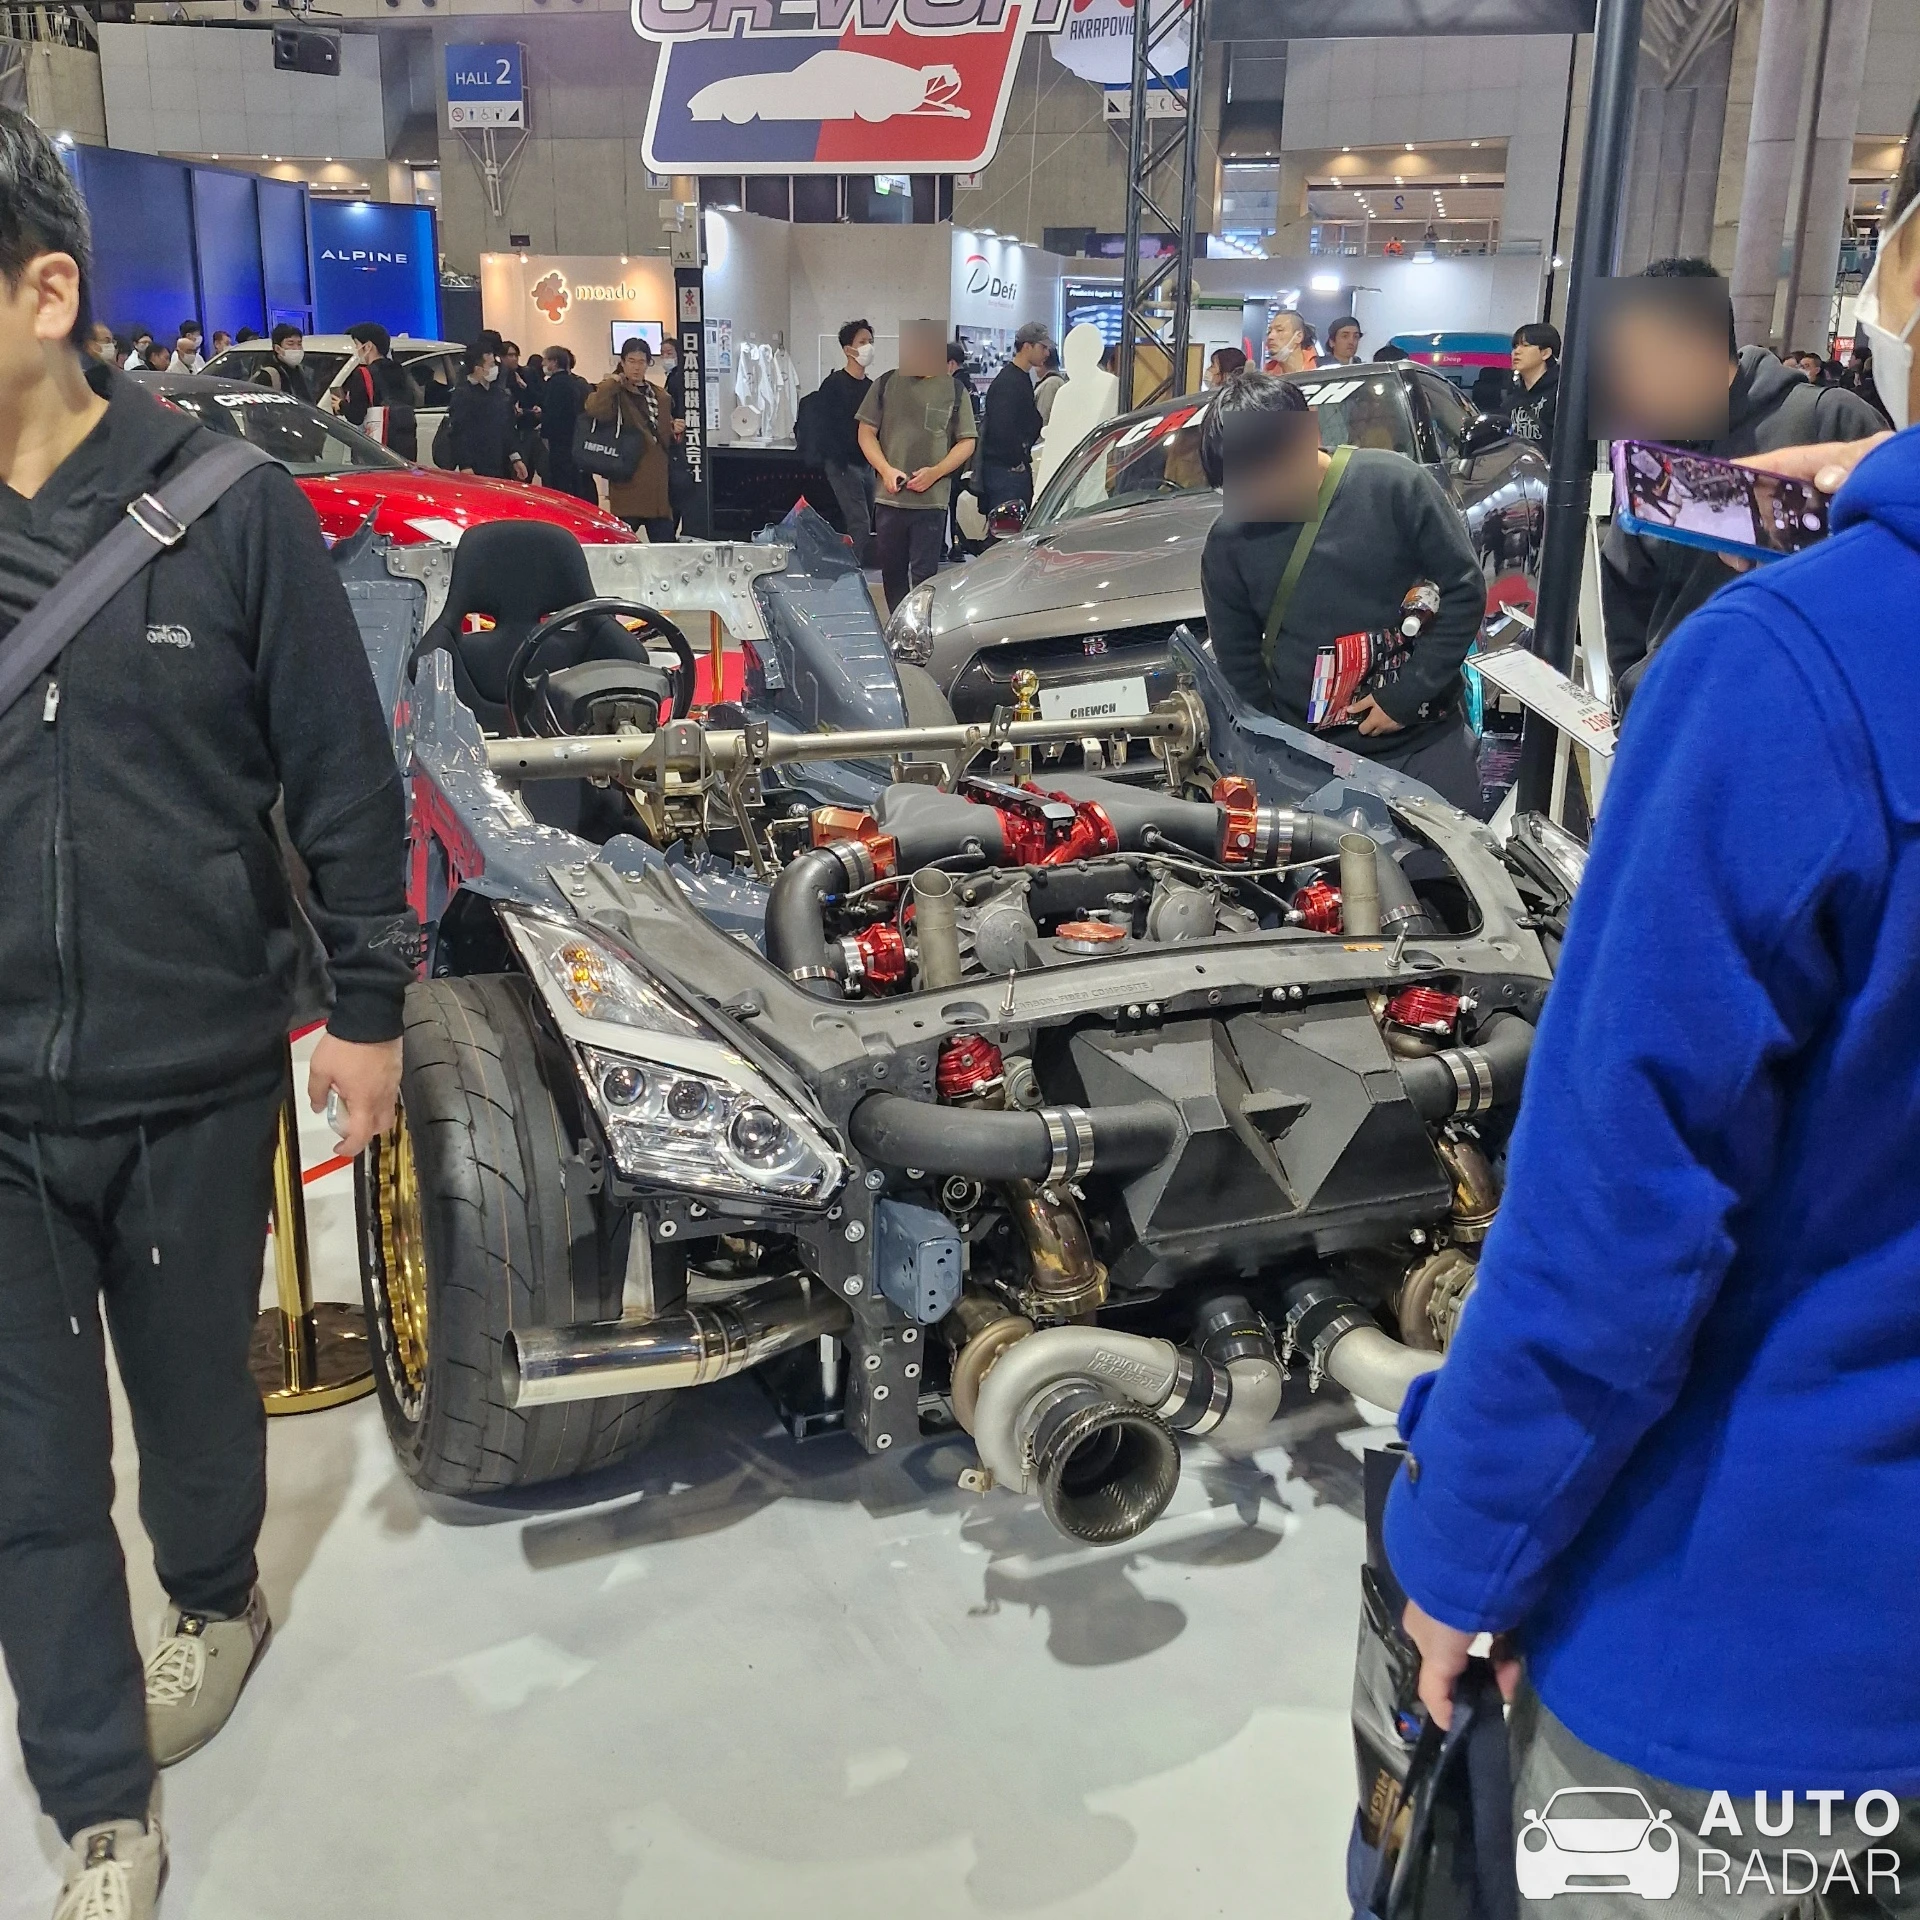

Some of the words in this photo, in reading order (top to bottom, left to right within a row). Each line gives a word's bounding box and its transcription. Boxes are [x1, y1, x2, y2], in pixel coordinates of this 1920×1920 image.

[455, 71, 492, 85] HALL
[496, 58, 512, 85] 2
[321, 249, 408, 264] ALPINE
[576, 282, 636, 300] moado
[1070, 703, 1116, 719] CREWCH
[1092, 982, 1149, 997] COMPOSITE
